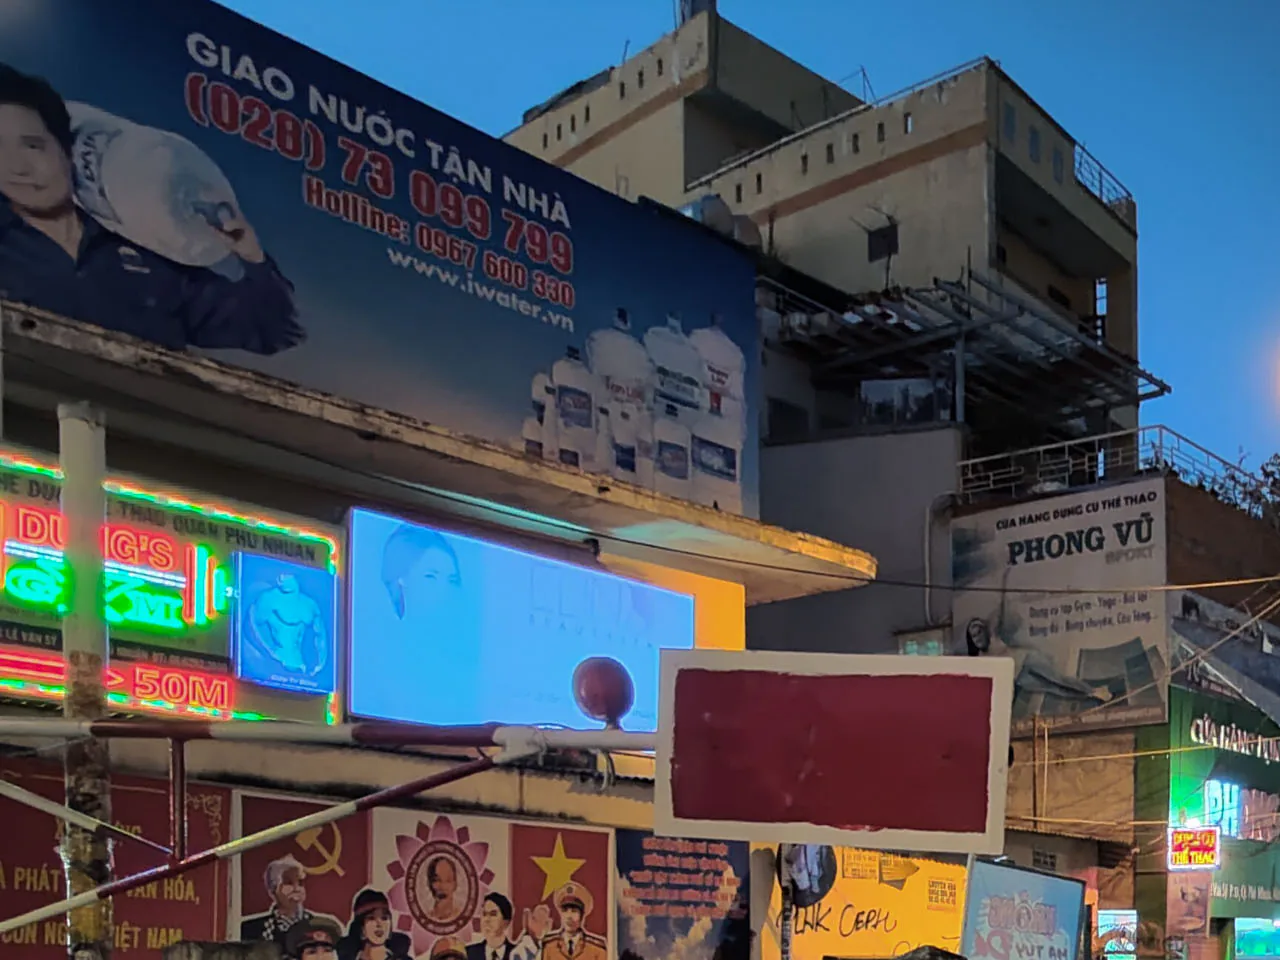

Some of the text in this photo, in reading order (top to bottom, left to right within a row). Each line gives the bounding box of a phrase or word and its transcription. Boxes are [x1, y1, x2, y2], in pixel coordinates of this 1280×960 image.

[186, 32, 571, 229] GIAO NƯỚC TẬN NHÀ
[184, 72, 574, 275] (028) 73 099 799
[303, 172, 576, 309] Hotline: 0967 600 330
[387, 247, 574, 333] www.iwater.vn
[1007, 512, 1154, 566] PHONG VŨ
[135, 666, 229, 709] 50M
[15, 862, 61, 893] PHÁT
[114, 920, 141, 952] IỆT
